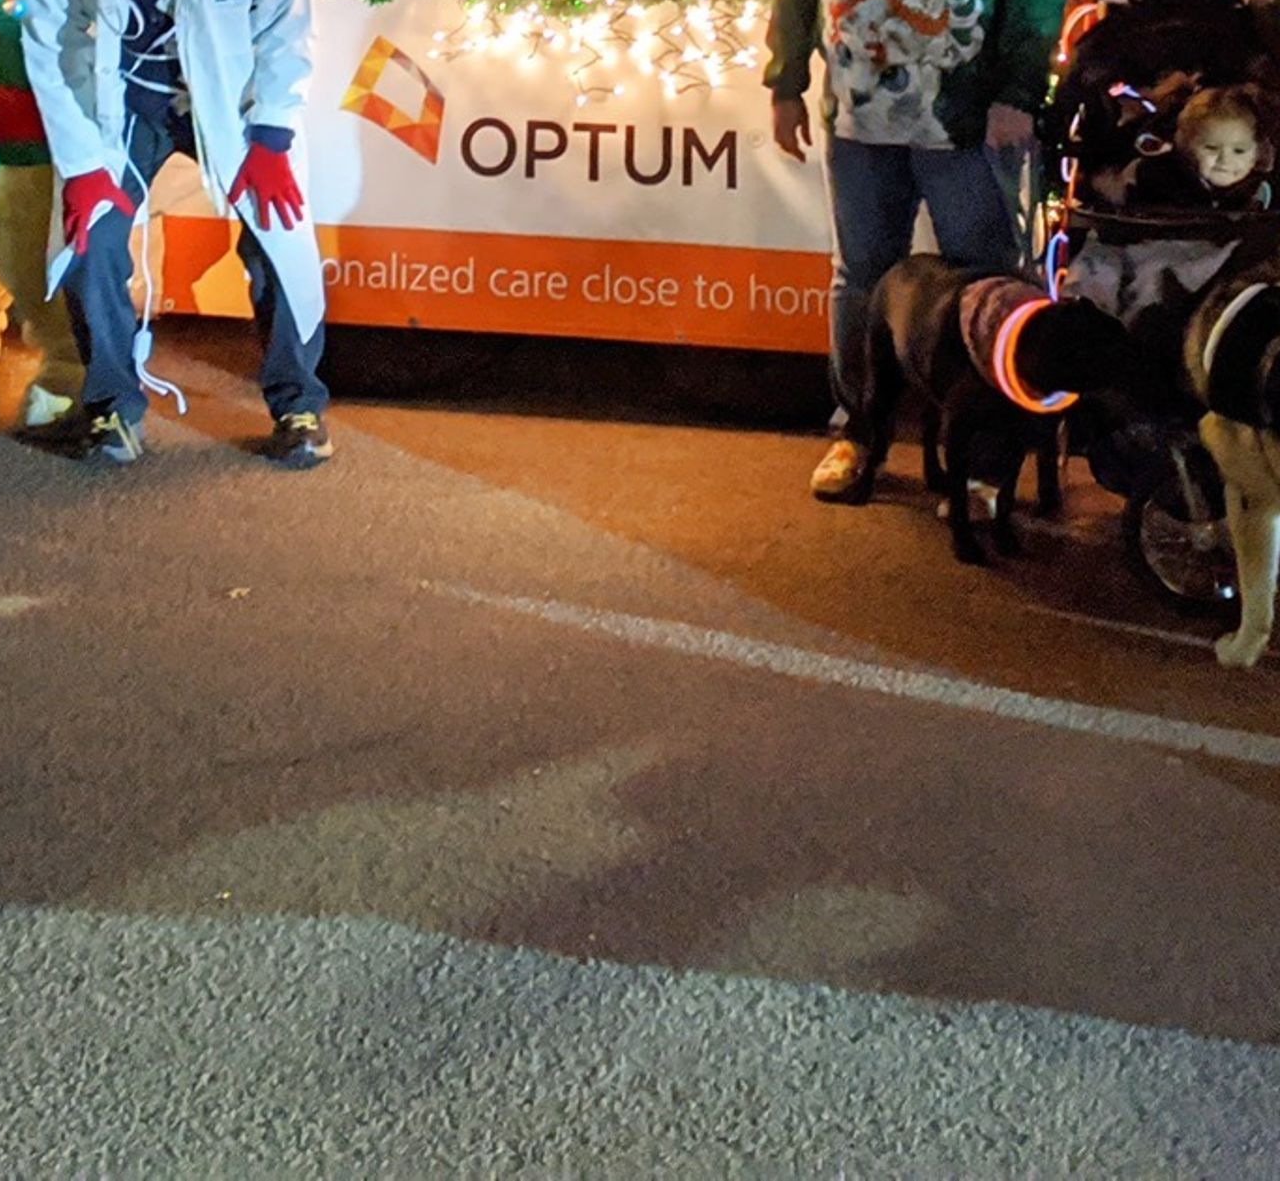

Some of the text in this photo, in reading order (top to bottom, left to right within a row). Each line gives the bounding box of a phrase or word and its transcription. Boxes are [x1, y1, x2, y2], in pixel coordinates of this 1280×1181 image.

[460, 117, 738, 190] OPTUM
[319, 251, 834, 317] onalized care close to hom
